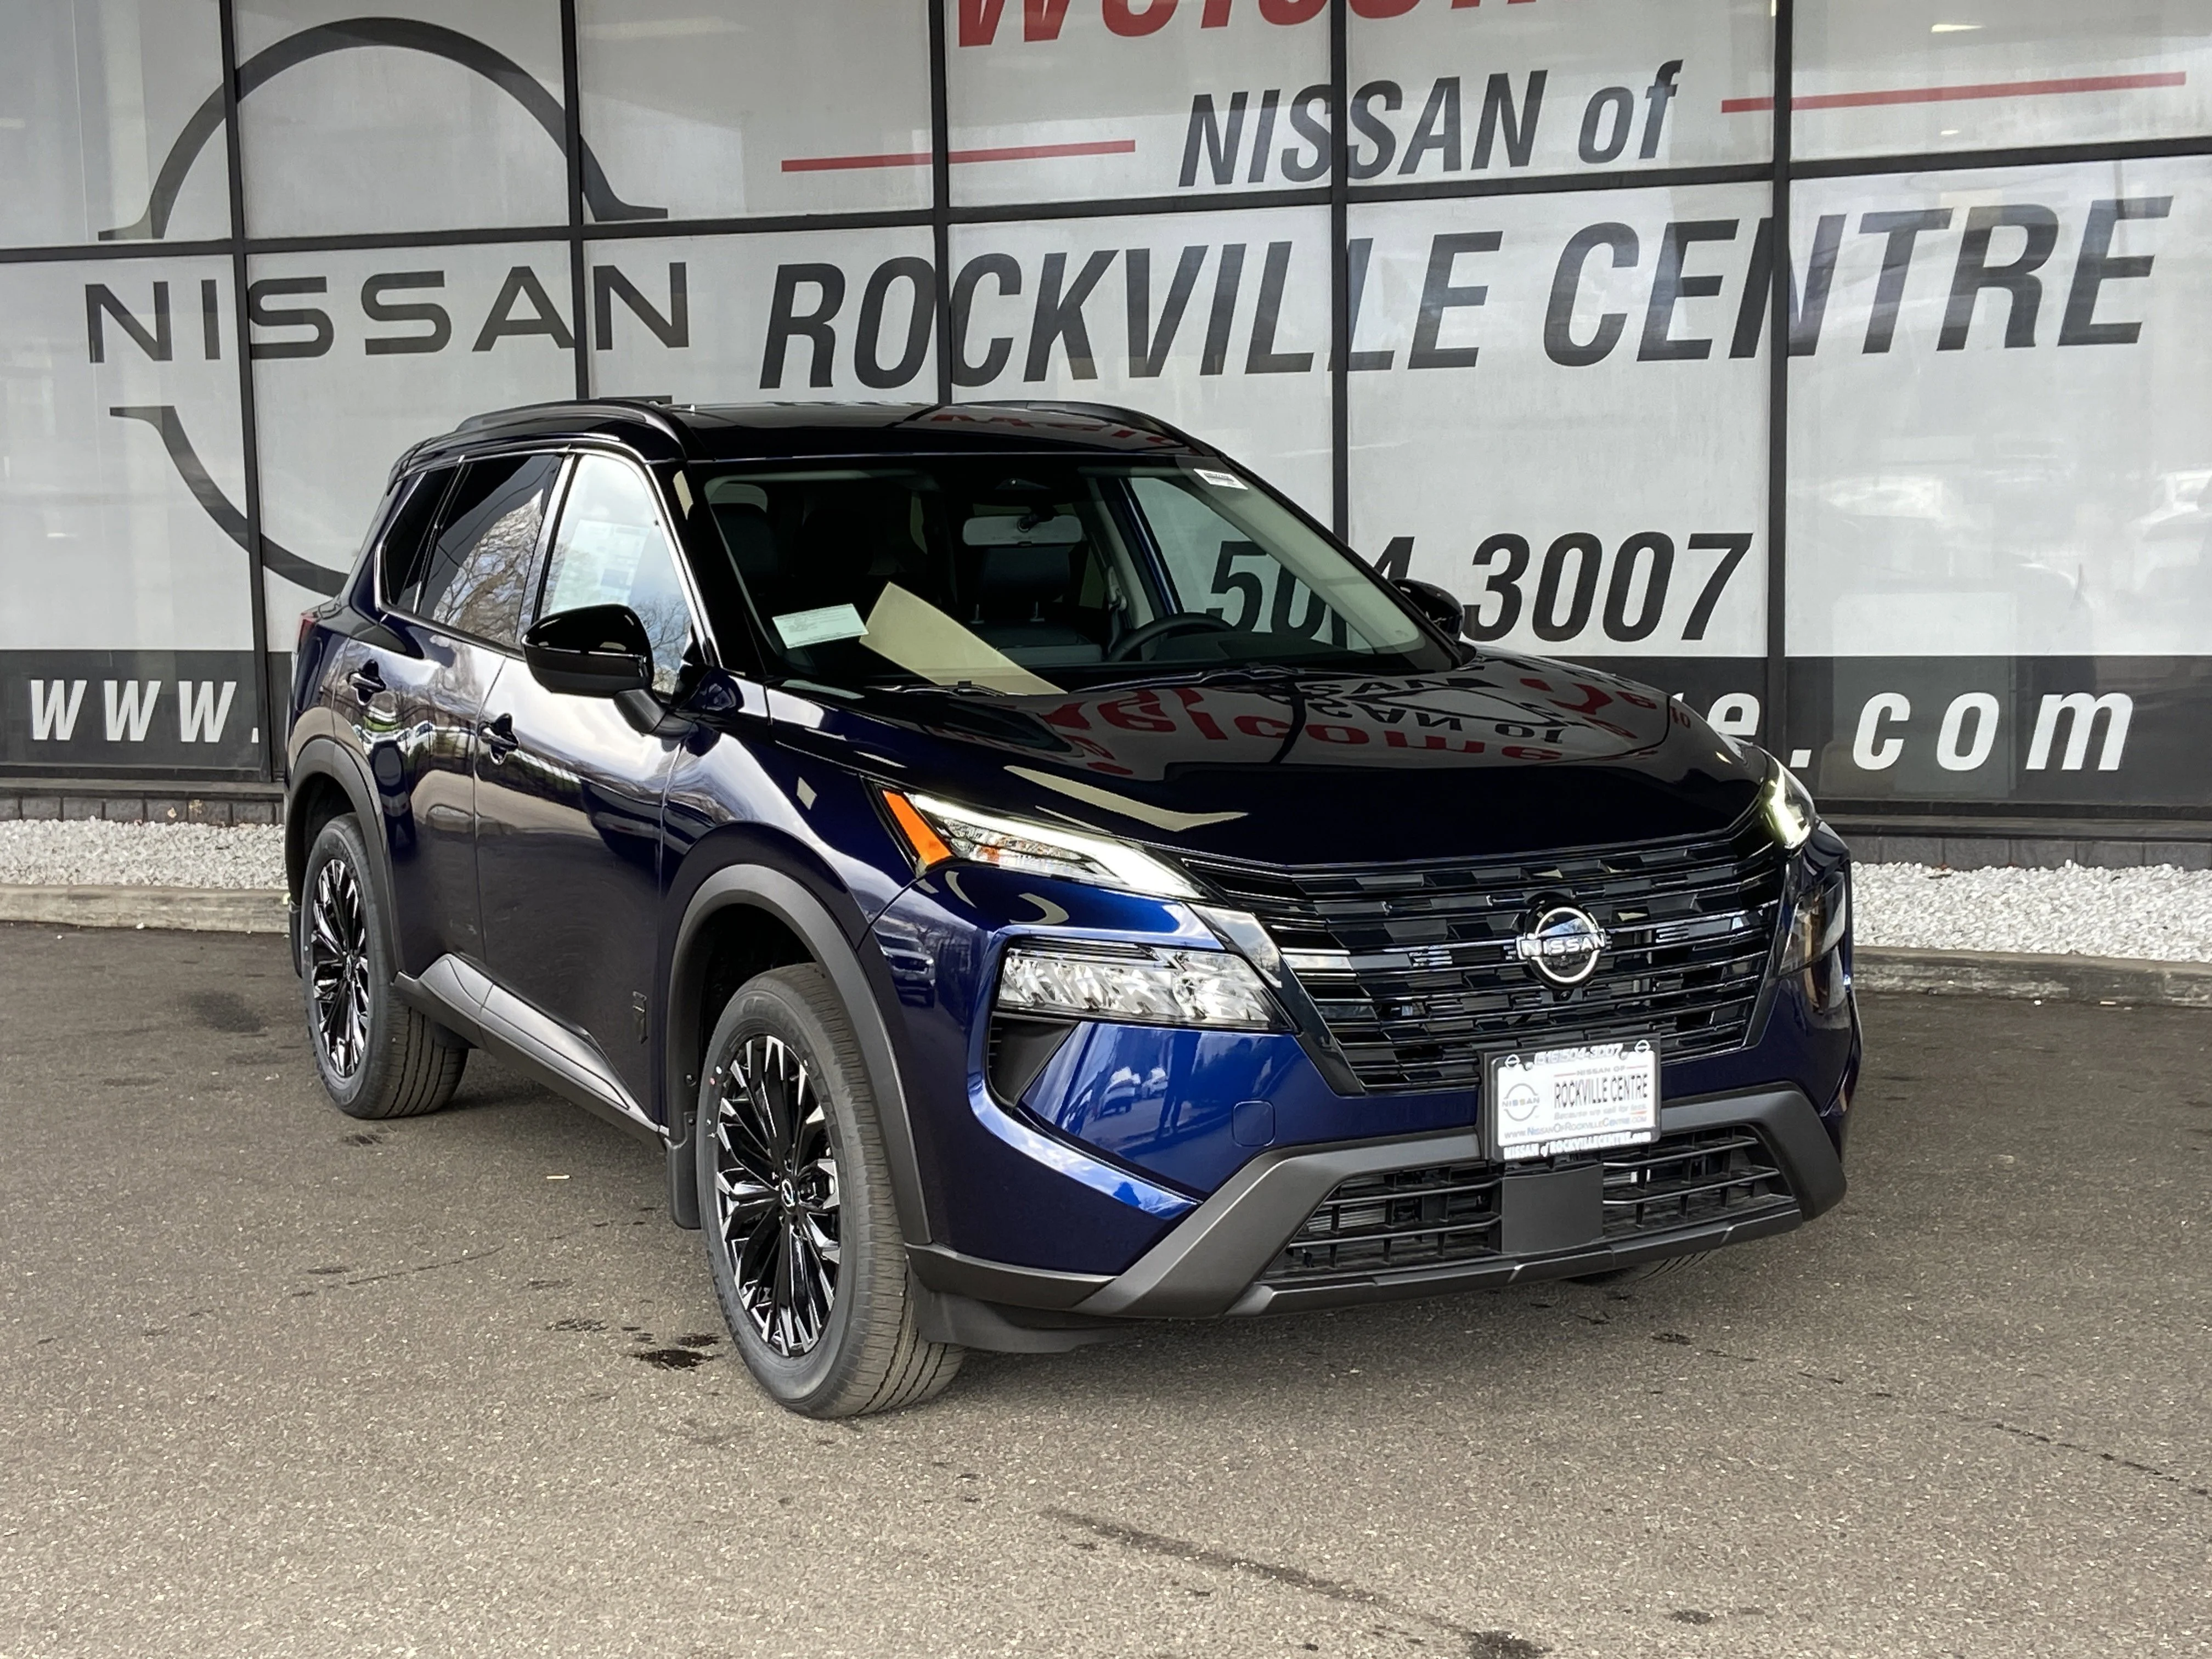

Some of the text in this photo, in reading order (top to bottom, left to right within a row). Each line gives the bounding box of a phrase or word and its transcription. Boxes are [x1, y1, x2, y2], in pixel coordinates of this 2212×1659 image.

[1178, 59, 1684, 188] NISSAN of
[759, 195, 2174, 390] ROCKVILLE CENTRE
[84, 261, 690, 364] NISSAN
[1523, 934, 1605, 956] NISSAN
[1576, 1066, 1611, 1076] NISSAN
[1502, 1096, 1540, 1107] NISSAN
[1554, 1072, 1648, 1109] ROCKVILLE CENTRE
